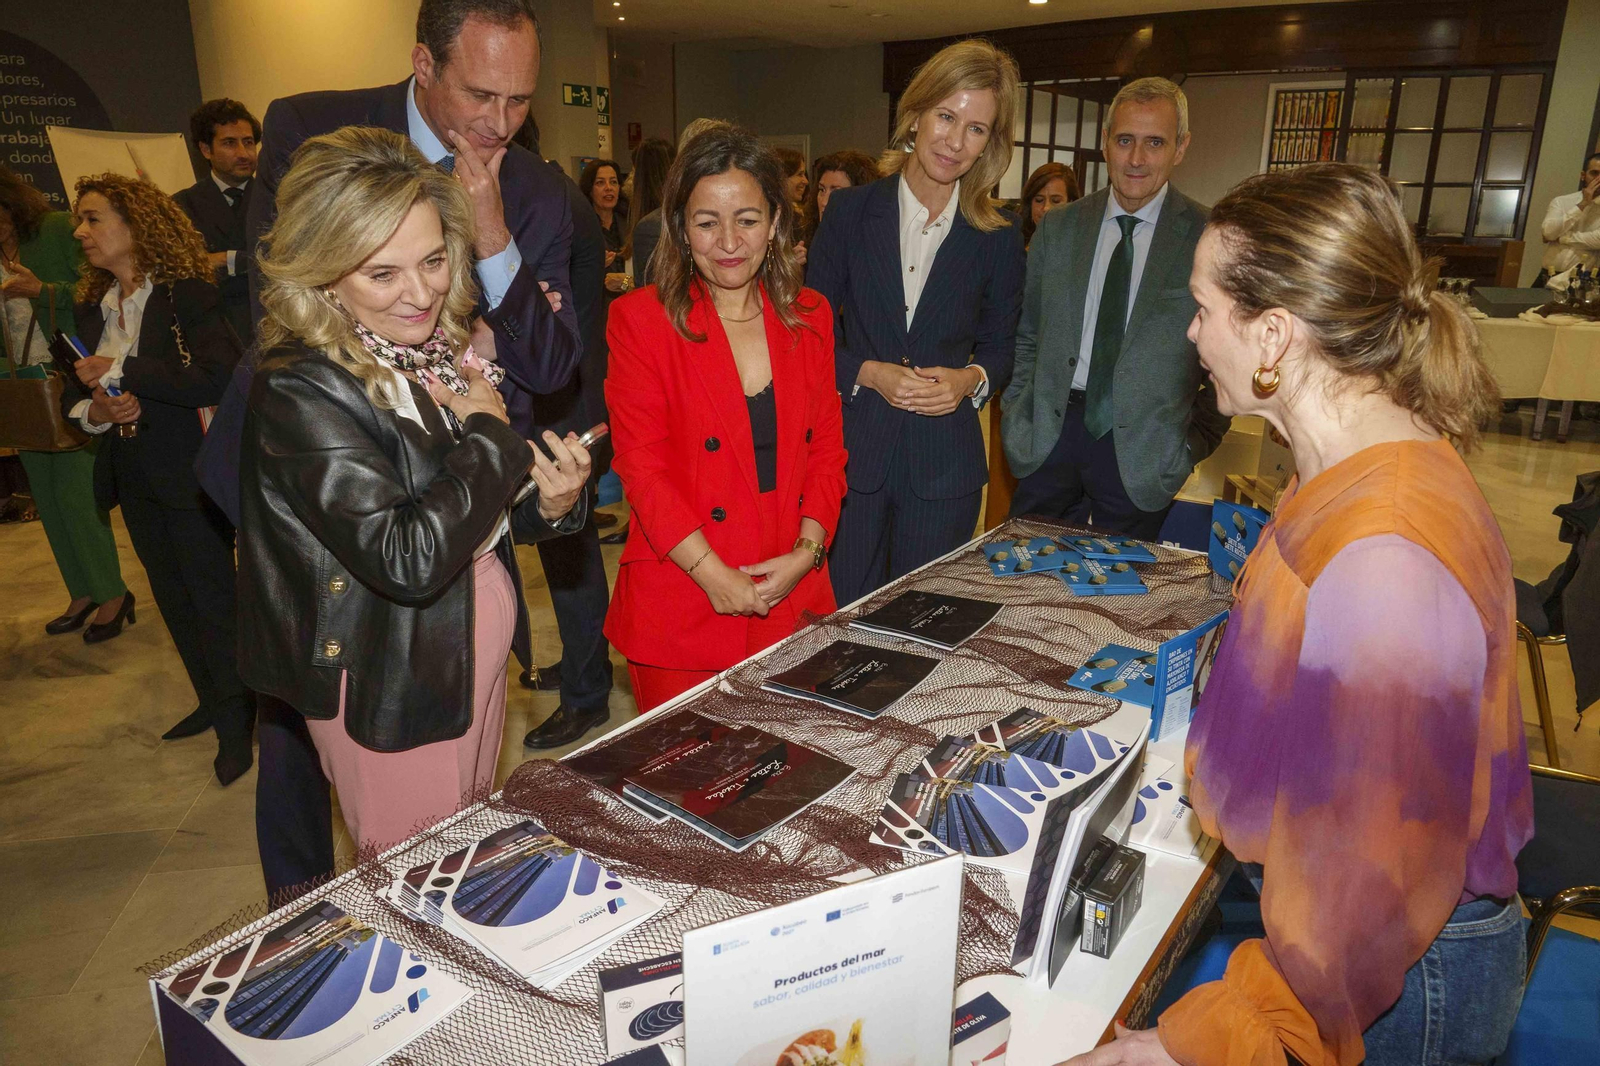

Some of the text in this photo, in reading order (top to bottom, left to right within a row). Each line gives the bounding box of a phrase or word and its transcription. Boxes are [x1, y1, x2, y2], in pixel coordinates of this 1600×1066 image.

[0, 93, 76, 108] presarios
[1, 110, 71, 126] Un lugar
[578, 908, 605, 924] ANFACO
[290, 919, 327, 943] desde 1904
[774, 948, 886, 989] Productos del mar
[753, 955, 904, 1009] sabor, calidad y bienestar
[373, 1006, 406, 1030] ANFACO
[961, 1022, 971, 1030] DE
[969, 1014, 987, 1026] OLIVA
